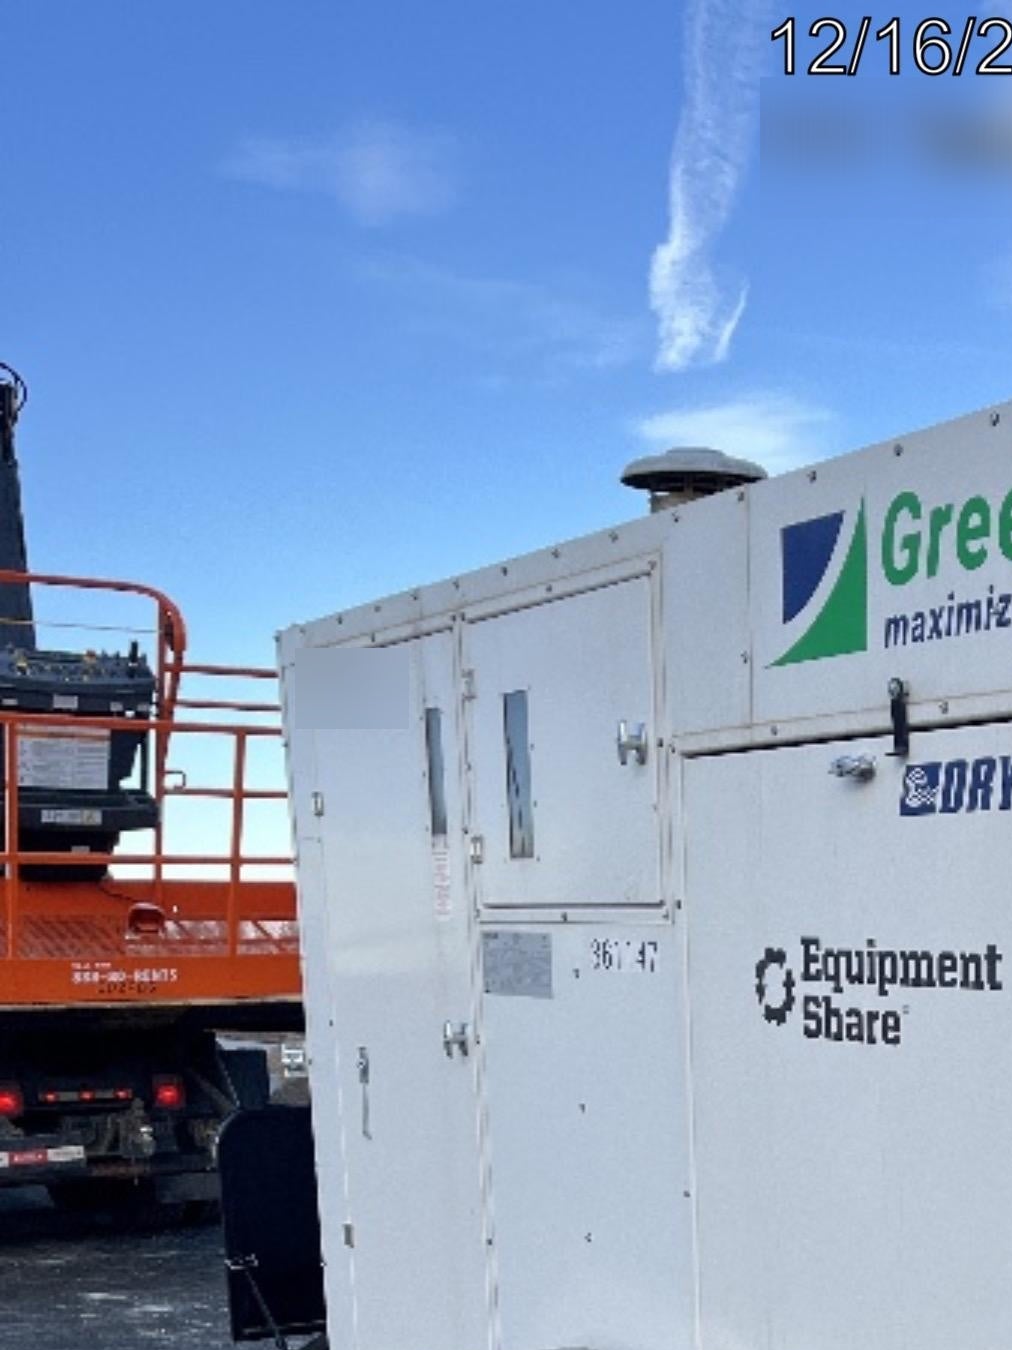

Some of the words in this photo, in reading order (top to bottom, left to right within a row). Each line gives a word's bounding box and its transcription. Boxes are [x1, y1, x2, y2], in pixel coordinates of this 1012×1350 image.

[591, 938, 658, 973] 36147
[800, 935, 1003, 997] Equipment
[802, 994, 901, 1046] Share
